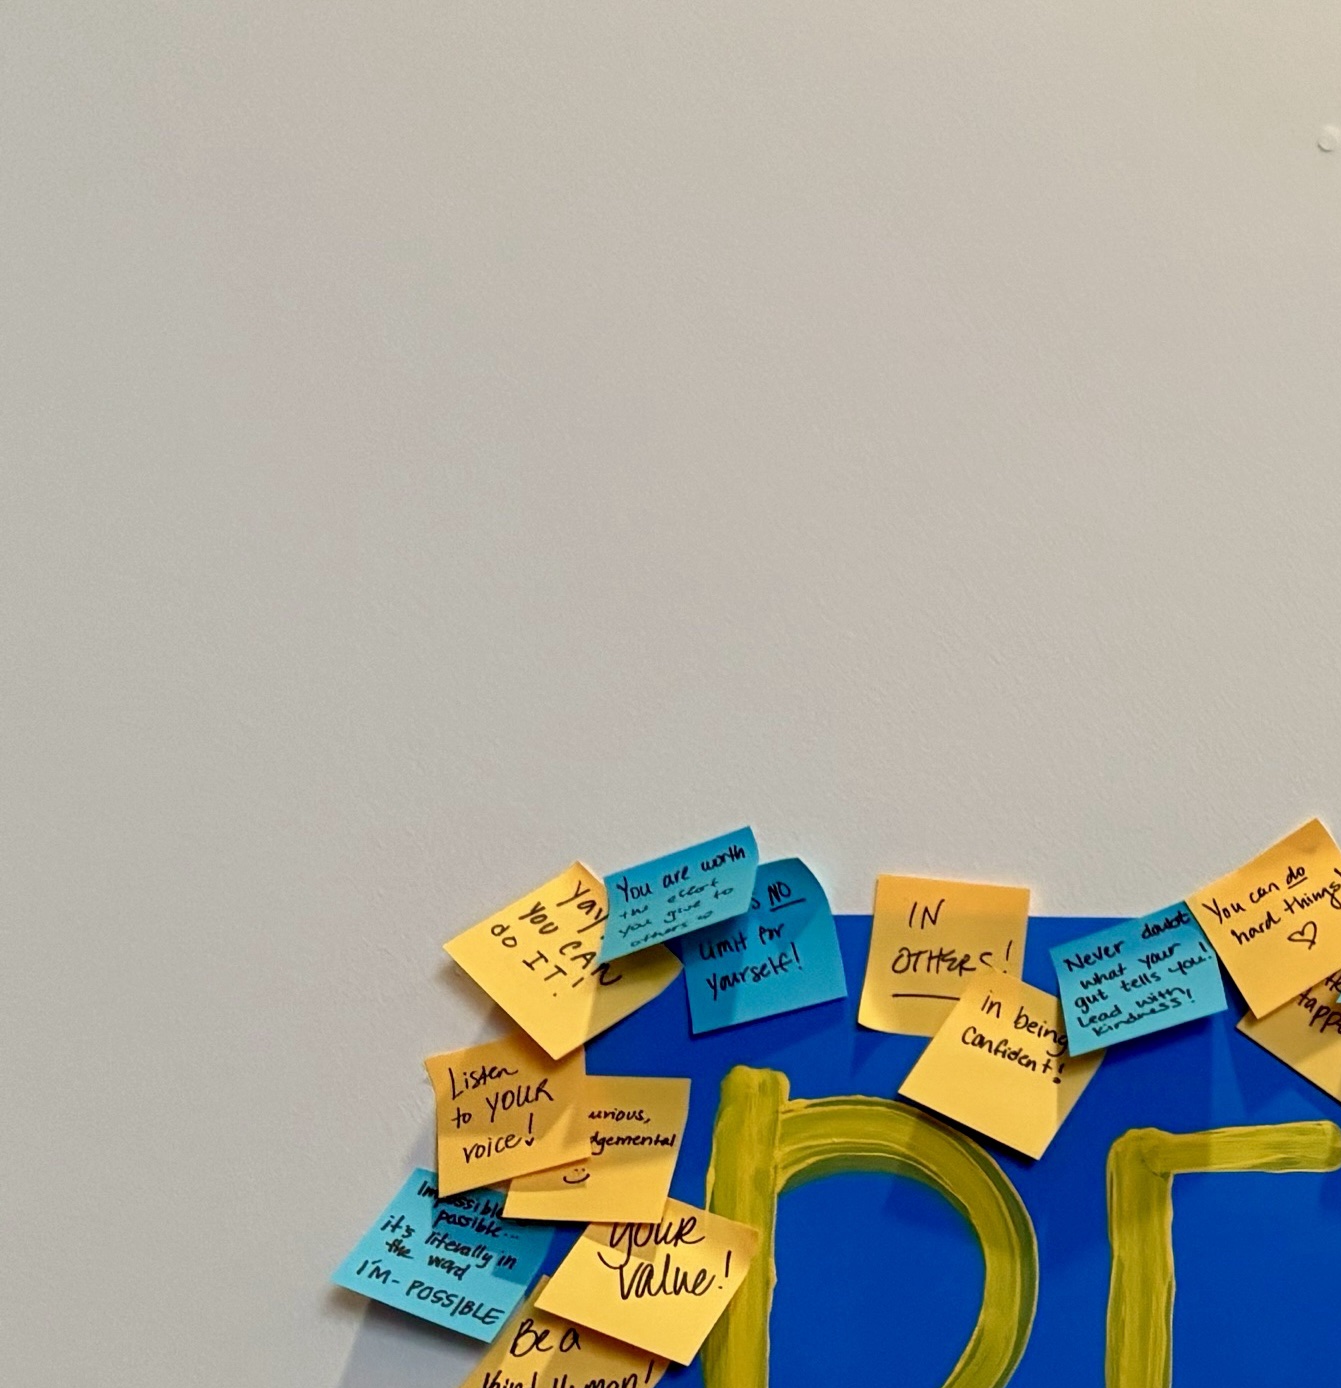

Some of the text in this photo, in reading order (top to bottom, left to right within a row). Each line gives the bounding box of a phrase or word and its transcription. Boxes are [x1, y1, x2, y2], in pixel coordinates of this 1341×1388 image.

[617, 847, 746, 902] You worth
[768, 882, 791, 902] NO
[1201, 863, 1307, 925] You can do
[907, 899, 945, 929] IN
[1231, 911, 1281, 945] hard
[1063, 911, 1191, 972] Never doubt
[523, 950, 583, 997] IT!
[706, 943, 803, 999] yourself!
[1013, 1007, 1069, 1057] being
[449, 1065, 518, 1099] Listen
[463, 1113, 536, 1164] voice!
[619, 1251, 731, 1299] value!
[405, 1279, 505, 1326] POSSIBLE
[510, 1319, 554, 1357] Be
